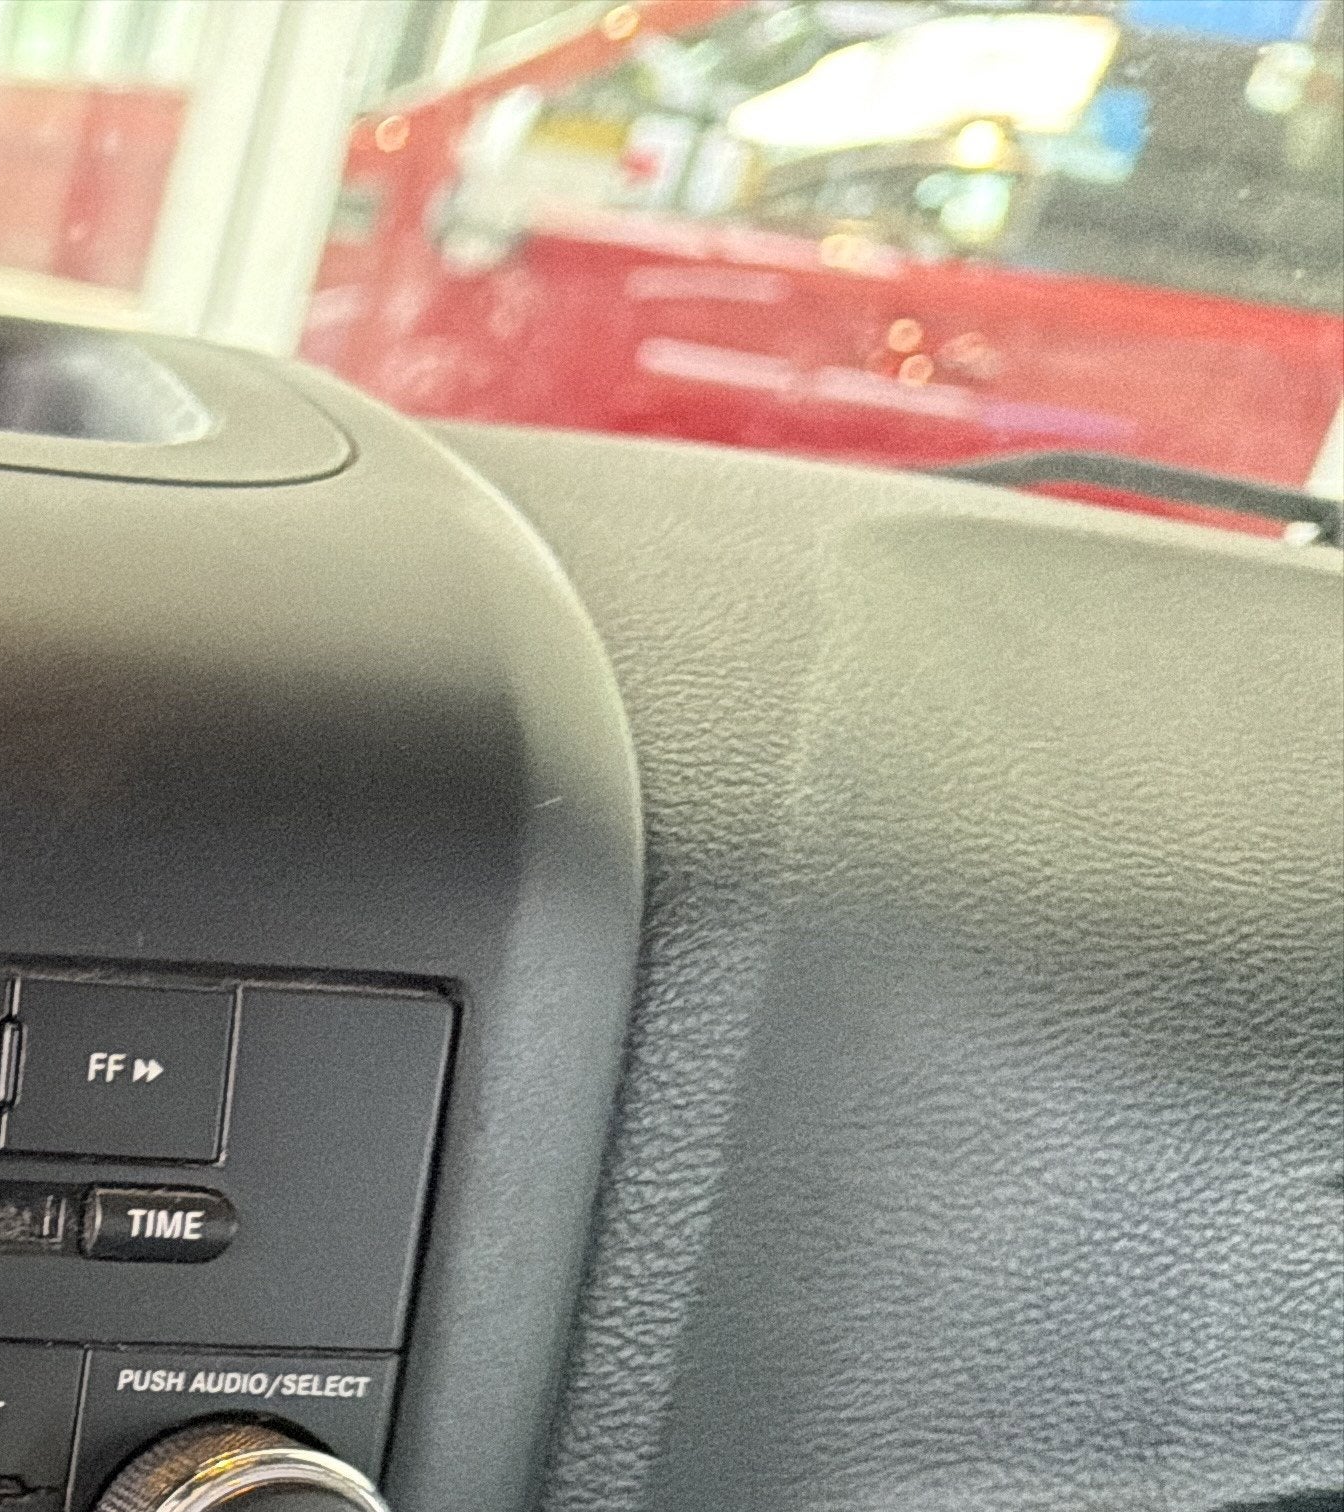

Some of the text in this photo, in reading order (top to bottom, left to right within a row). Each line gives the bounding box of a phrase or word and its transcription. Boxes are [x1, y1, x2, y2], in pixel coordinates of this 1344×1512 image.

[87, 1052, 127, 1082] FF
[127, 1208, 204, 1240] TIME
[116, 1367, 373, 1400] PUSH AUDIO/SELECT
